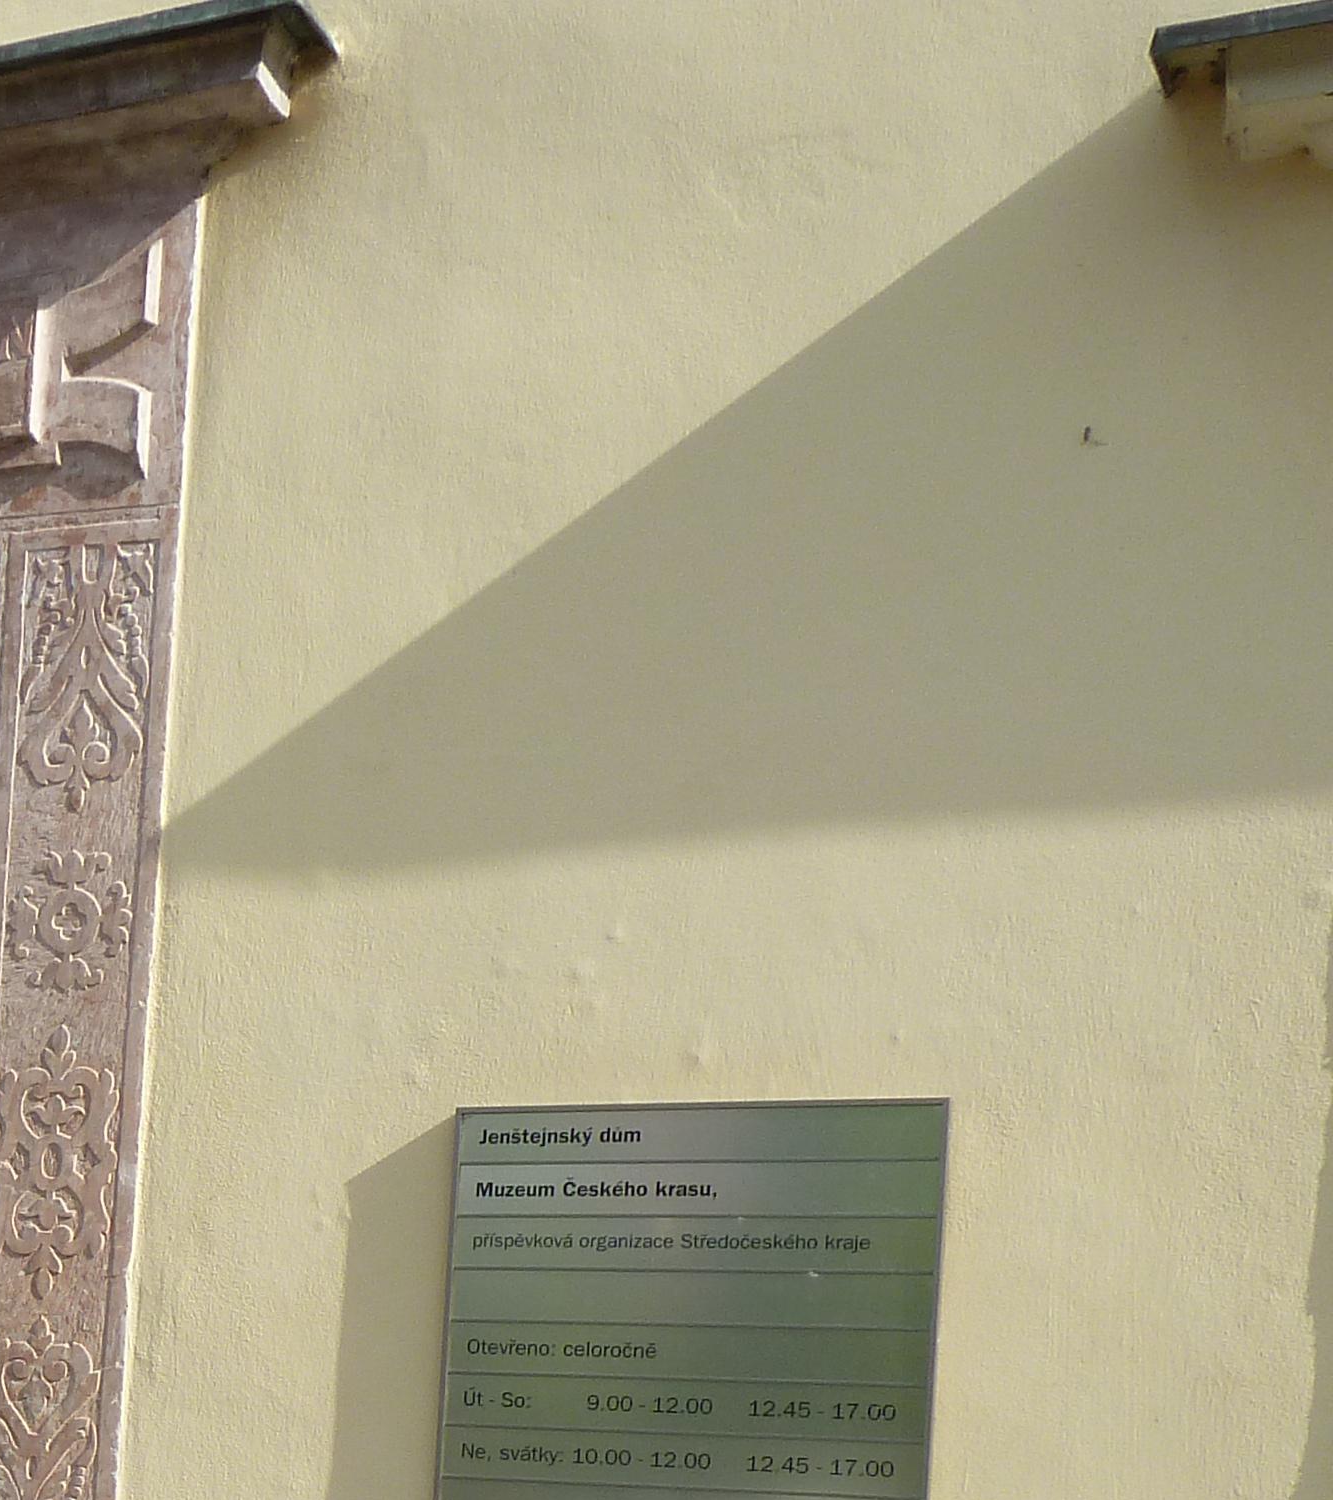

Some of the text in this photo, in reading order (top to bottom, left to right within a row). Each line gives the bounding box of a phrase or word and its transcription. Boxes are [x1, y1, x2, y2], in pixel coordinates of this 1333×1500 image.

[479, 1126, 642, 1147] Jenštejnský dům
[475, 1177, 718, 1199] Muzeum Českého krasu,
[472, 1233, 871, 1253] příspěvková organizace Středočeského kraje
[466, 1338, 657, 1360] Otevřeno: celoročně
[463, 1387, 483, 1407] Út
[501, 1392, 532, 1409] So:
[586, 1394, 633, 1412] 9.00
[652, 1397, 714, 1415] 12.00
[748, 1400, 811, 1419] 12.45
[832, 1403, 896, 1421] 17.00
[460, 1443, 492, 1463] Ne,
[499, 1446, 564, 1466] svátky:
[572, 1448, 632, 1466] 10.00
[649, 1452, 712, 1470] 12.00
[746, 1456, 809, 1474] 12.45
[829, 1459, 895, 1478] 17.00
